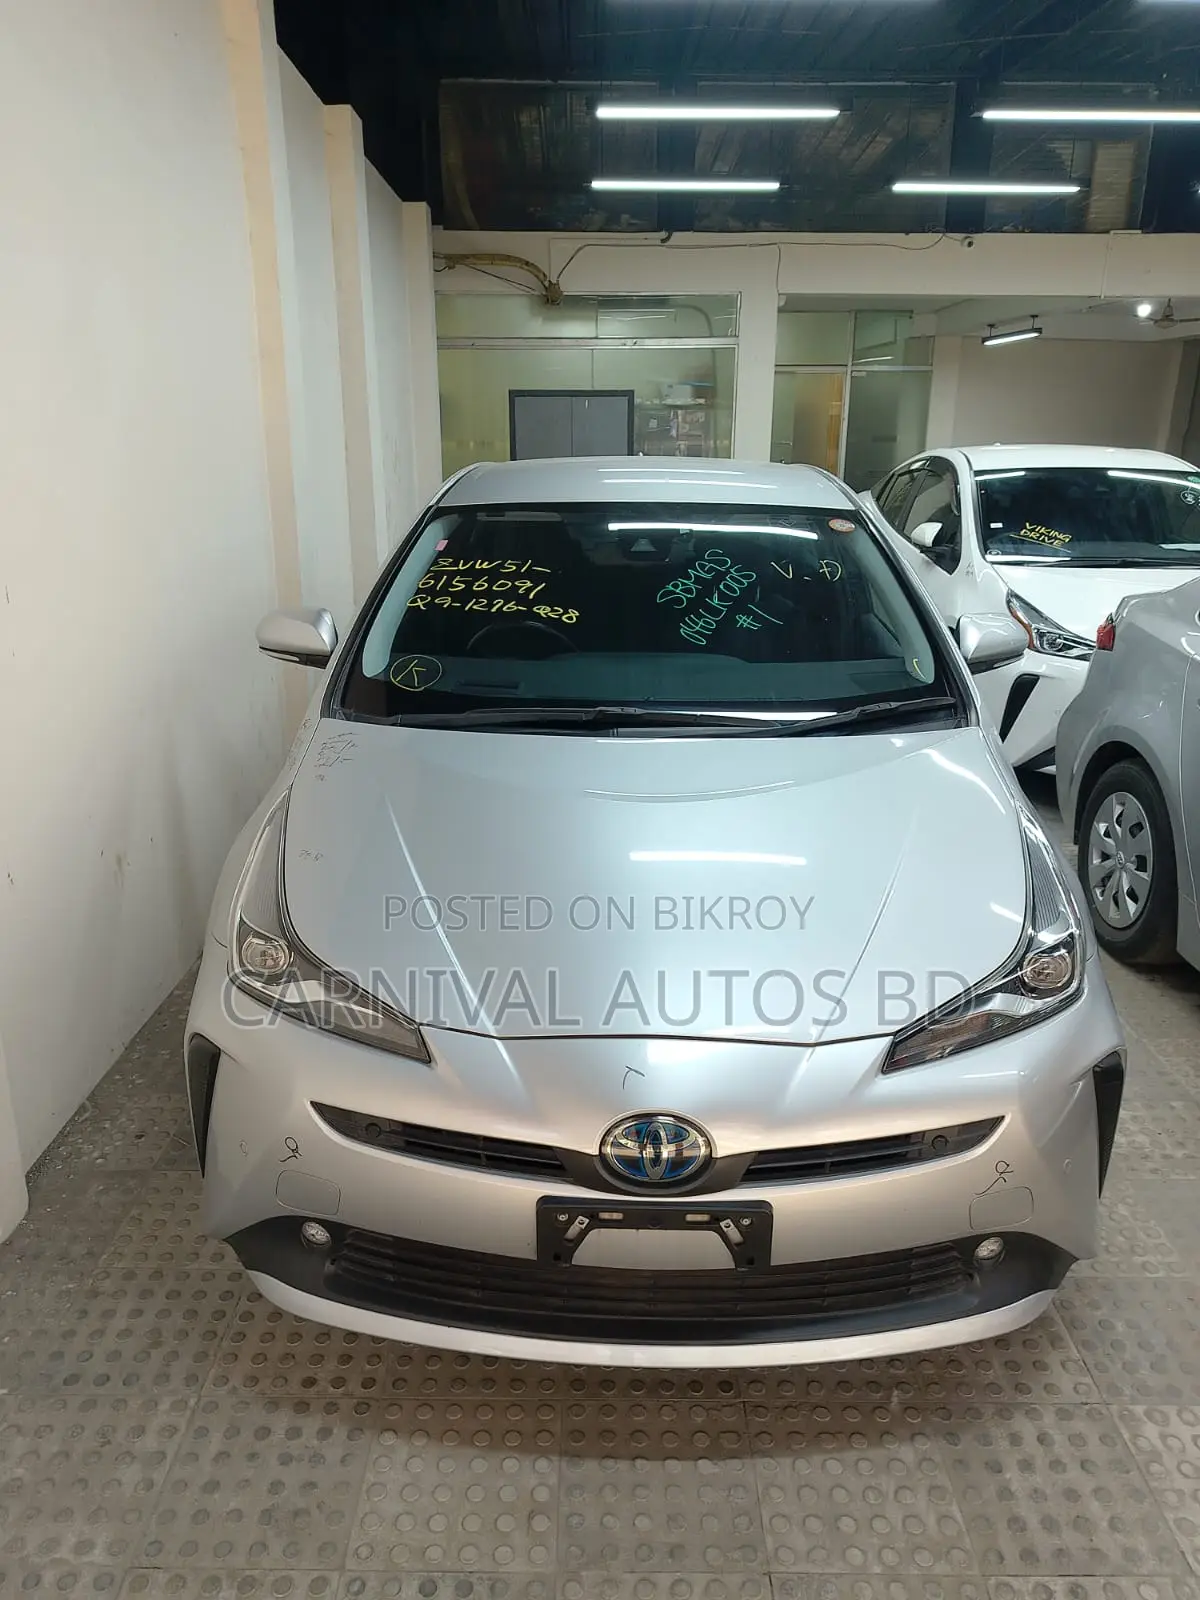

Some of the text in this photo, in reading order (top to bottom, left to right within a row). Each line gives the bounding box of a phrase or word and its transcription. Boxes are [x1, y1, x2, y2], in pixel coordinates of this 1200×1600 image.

[1019, 529, 1065, 547] DRIVE
[1025, 522, 1072, 543] VIKING
[417, 573, 547, 599] 6156091
